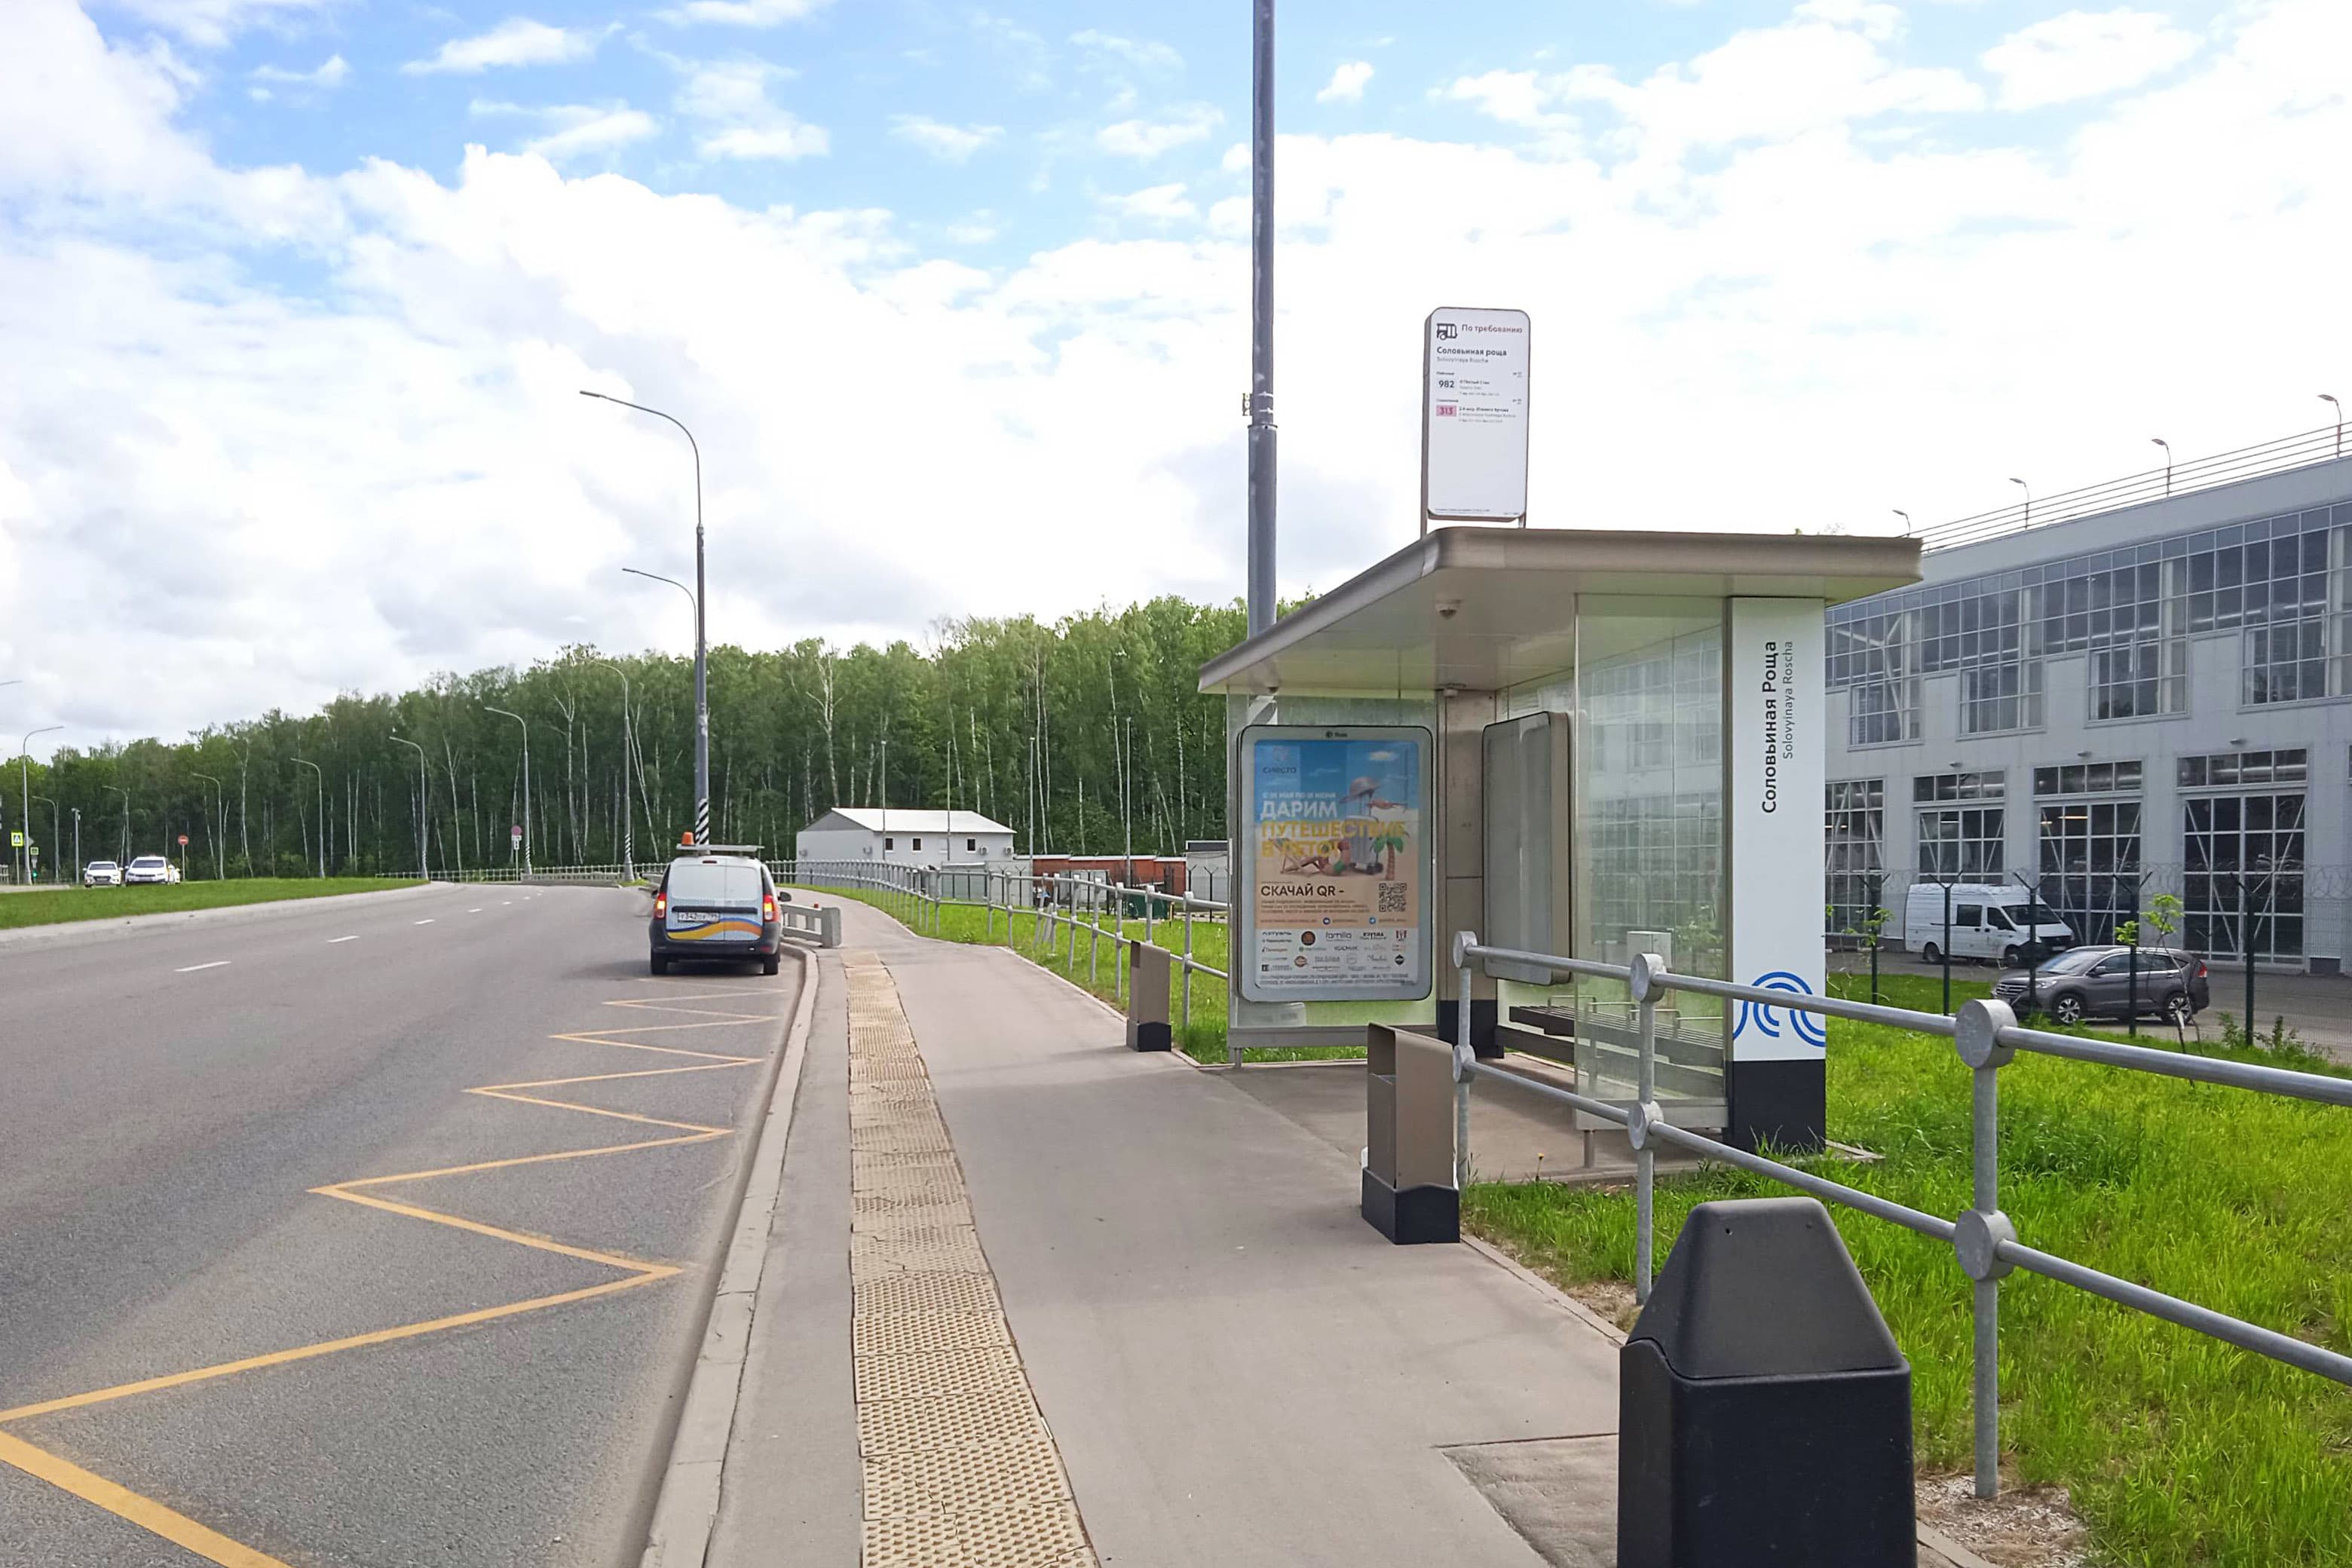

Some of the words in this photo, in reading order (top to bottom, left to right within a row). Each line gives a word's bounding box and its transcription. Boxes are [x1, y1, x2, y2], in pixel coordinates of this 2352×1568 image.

[1475, 324, 1523, 333] требованию
[1436, 346, 1484, 355] Соловьиная
[1438, 380, 1455, 388] 982
[1439, 407, 1453, 415] 313
[1762, 642, 1778, 692] Роща
[1782, 642, 1793, 684] Roscha
[1782, 688, 1795, 759] Solovyinaya
[1762, 699, 1777, 813] Соловьиная
[1260, 801, 1338, 820] ДАРИМ
[1261, 820, 1406, 838] ПУТЕШЕСТВИЕ
[1260, 884, 1313, 896] СКАЧАЙ
[1317, 885, 1335, 897] QR
